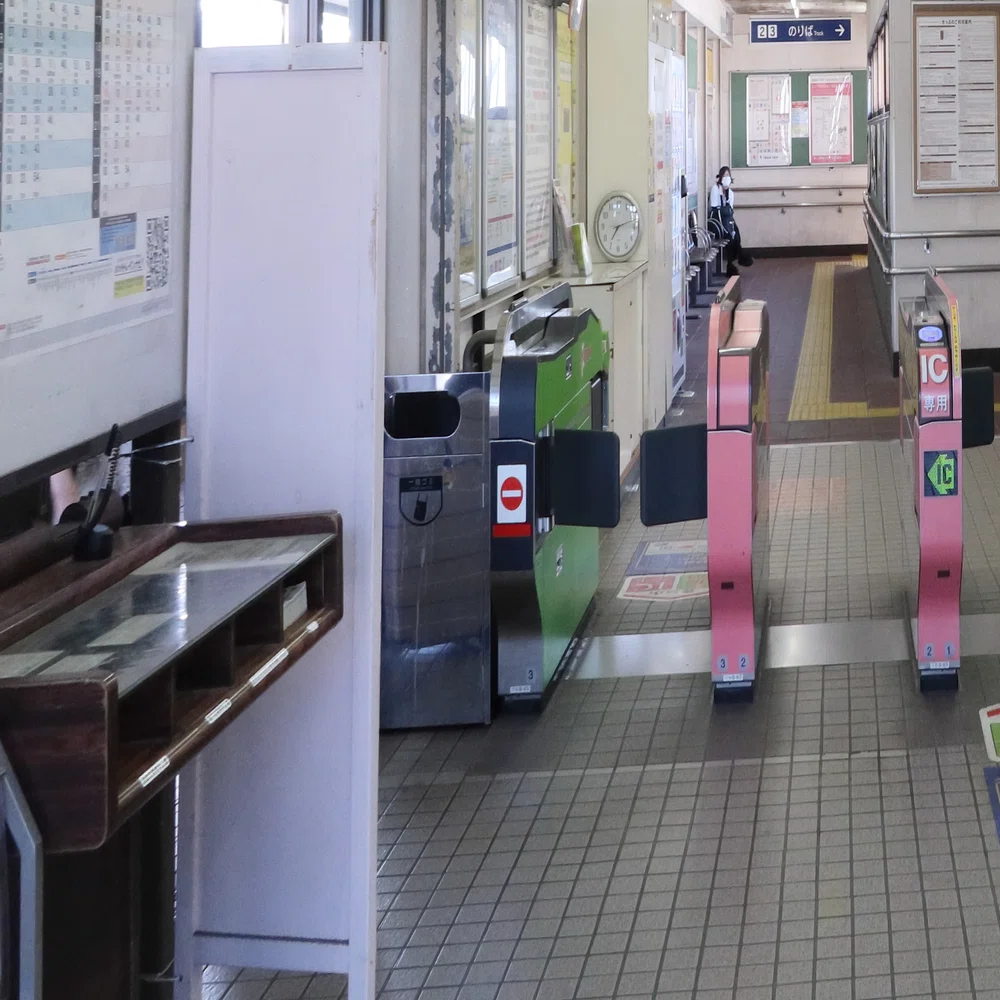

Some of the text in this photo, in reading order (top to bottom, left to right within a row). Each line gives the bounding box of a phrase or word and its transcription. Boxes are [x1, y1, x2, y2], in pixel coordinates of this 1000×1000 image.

[788, 25, 814, 38] のりば
[920, 353, 949, 385] IC
[923, 394, 948, 412] 専用
[936, 463, 953, 485] IC
